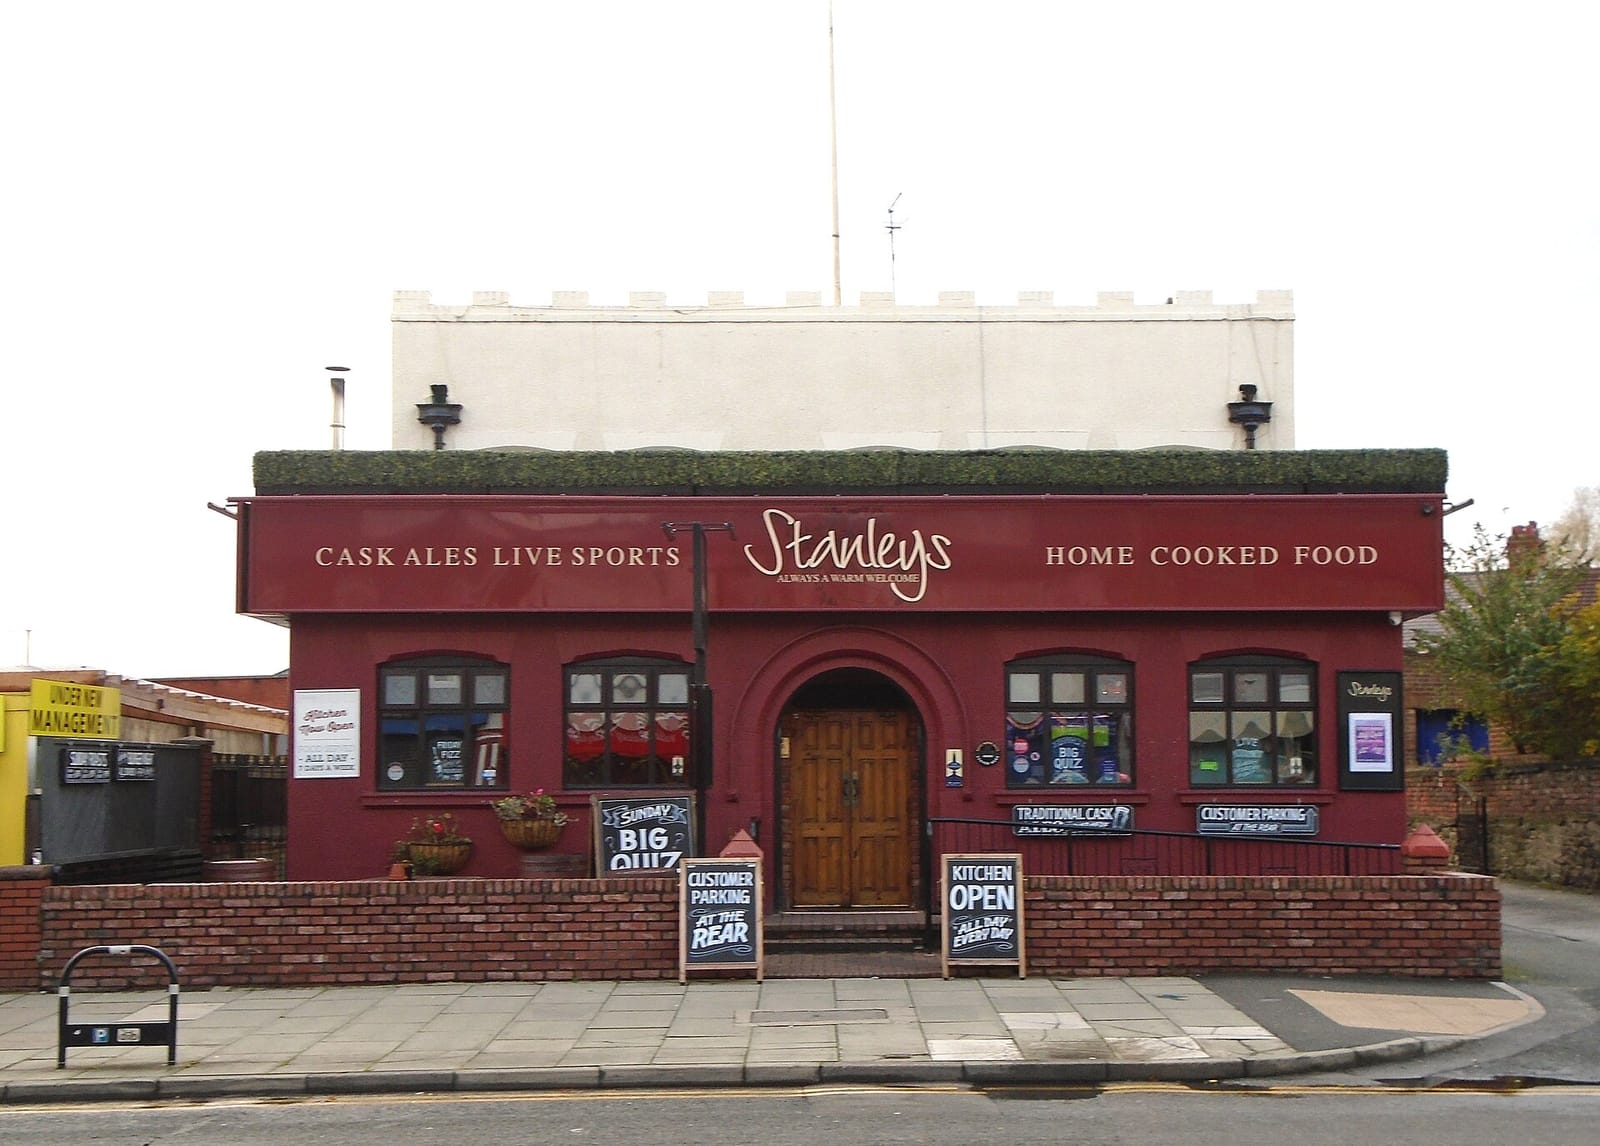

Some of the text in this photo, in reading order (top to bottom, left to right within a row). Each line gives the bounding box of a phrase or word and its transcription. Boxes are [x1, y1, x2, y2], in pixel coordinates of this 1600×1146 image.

[315, 547, 680, 566] CASK ALES LIVE SPORTS
[743, 508, 952, 602] Stanleys
[1045, 546, 1378, 565] HOME COOKED FOOD
[777, 574, 920, 584] ALWAYS A WARM WELCOME
[50, 685, 82, 706] UNDER
[32, 710, 118, 735] MANAGEMENT
[303, 709, 347, 722] Kitchen
[327, 721, 354, 733] Open
[304, 753, 349, 763] ALL DAY
[1059, 747, 1080, 758] BIG
[1053, 758, 1084, 770] QUIZ
[620, 805, 671, 825] SUNDAY
[1016, 807, 1115, 820] TRADITIONAL CASK
[1201, 807, 1306, 820] CUSTOMER PARKING
[619, 827, 669, 851] BIG
[687, 872, 754, 887] CUSTOMER
[952, 865, 1013, 881] KITCHEN
[691, 889, 751, 904] PARKING
[949, 884, 1015, 911] OPEN
[695, 910, 746, 927] AT THE
[957, 916, 1009, 935] ALL DAY
[691, 922, 749, 949] REAR
[953, 927, 1015, 948] EVERY DAY
